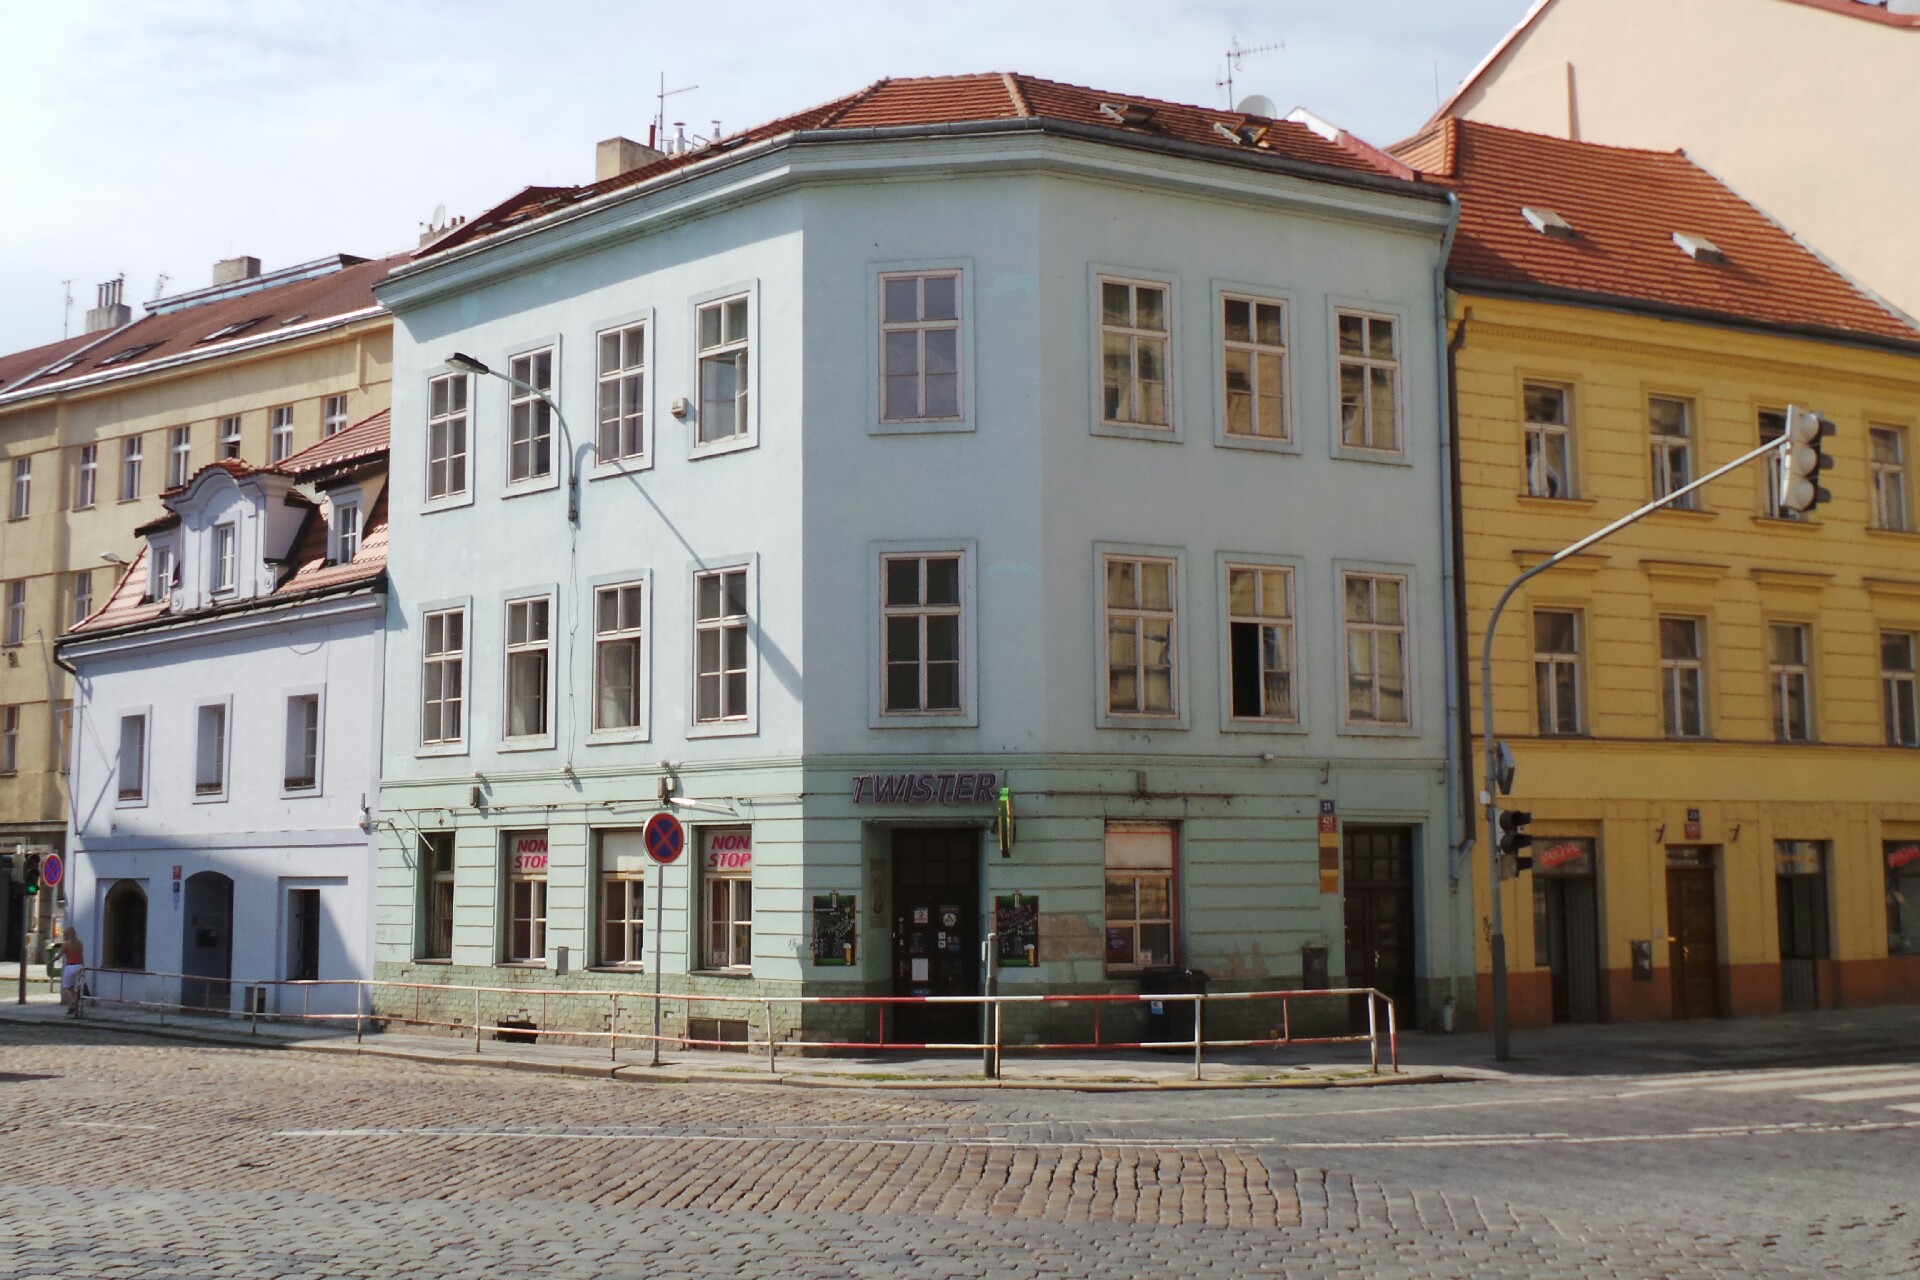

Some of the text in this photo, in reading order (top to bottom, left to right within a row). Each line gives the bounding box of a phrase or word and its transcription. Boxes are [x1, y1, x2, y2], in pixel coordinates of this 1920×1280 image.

[852, 773, 997, 803] TWISTER
[517, 839, 547, 852] NON
[711, 835, 750, 850] NON
[708, 853, 752, 867] STOP
